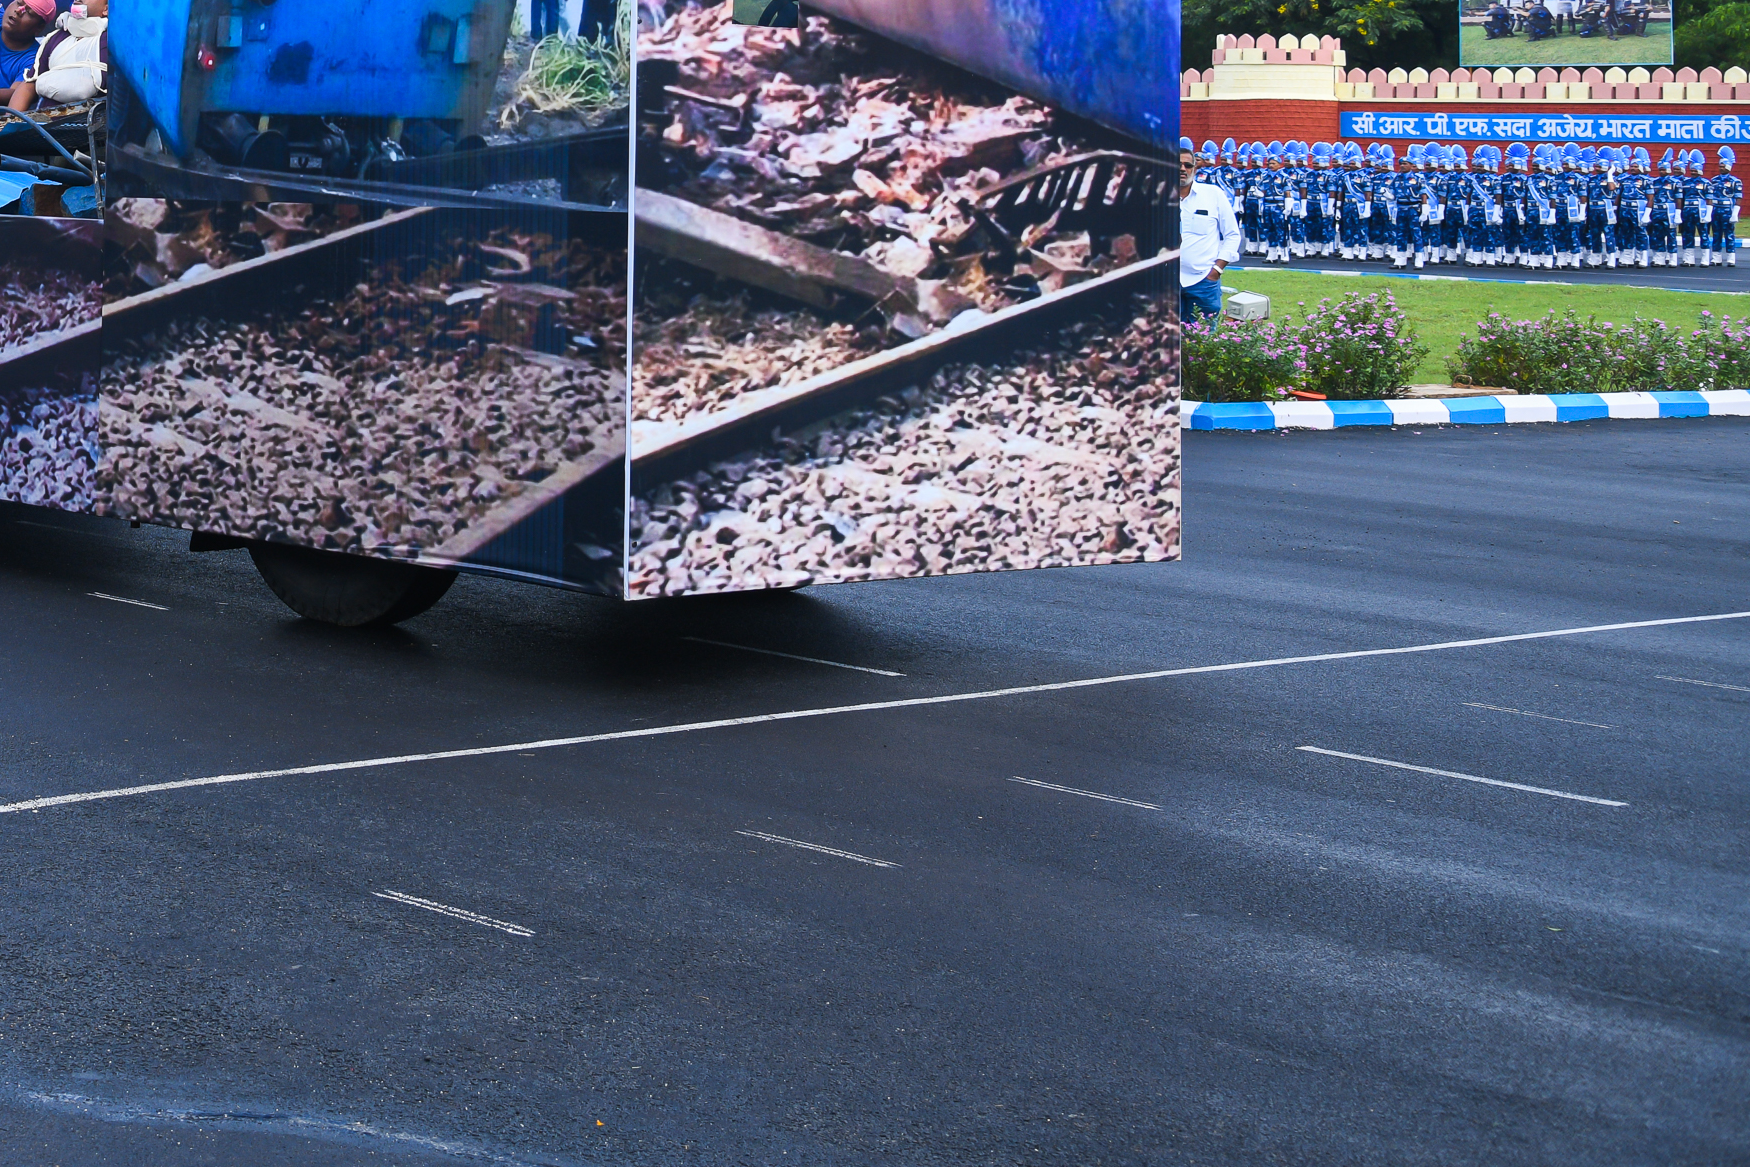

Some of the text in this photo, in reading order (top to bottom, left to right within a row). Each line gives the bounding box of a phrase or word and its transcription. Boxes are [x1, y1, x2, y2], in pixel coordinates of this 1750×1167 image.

[1351, 111, 1377, 134] सी.
[1378, 116, 1421, 136] आर.
[1423, 112, 1451, 136] पी.
[1452, 118, 1492, 137] एफ.
[1492, 118, 1534, 138] सदा
[1536, 113, 1597, 139] अजेय,
[1597, 119, 1654, 139] भारत
[1657, 120, 1705, 140] माता
[1710, 114, 1742, 140] की
